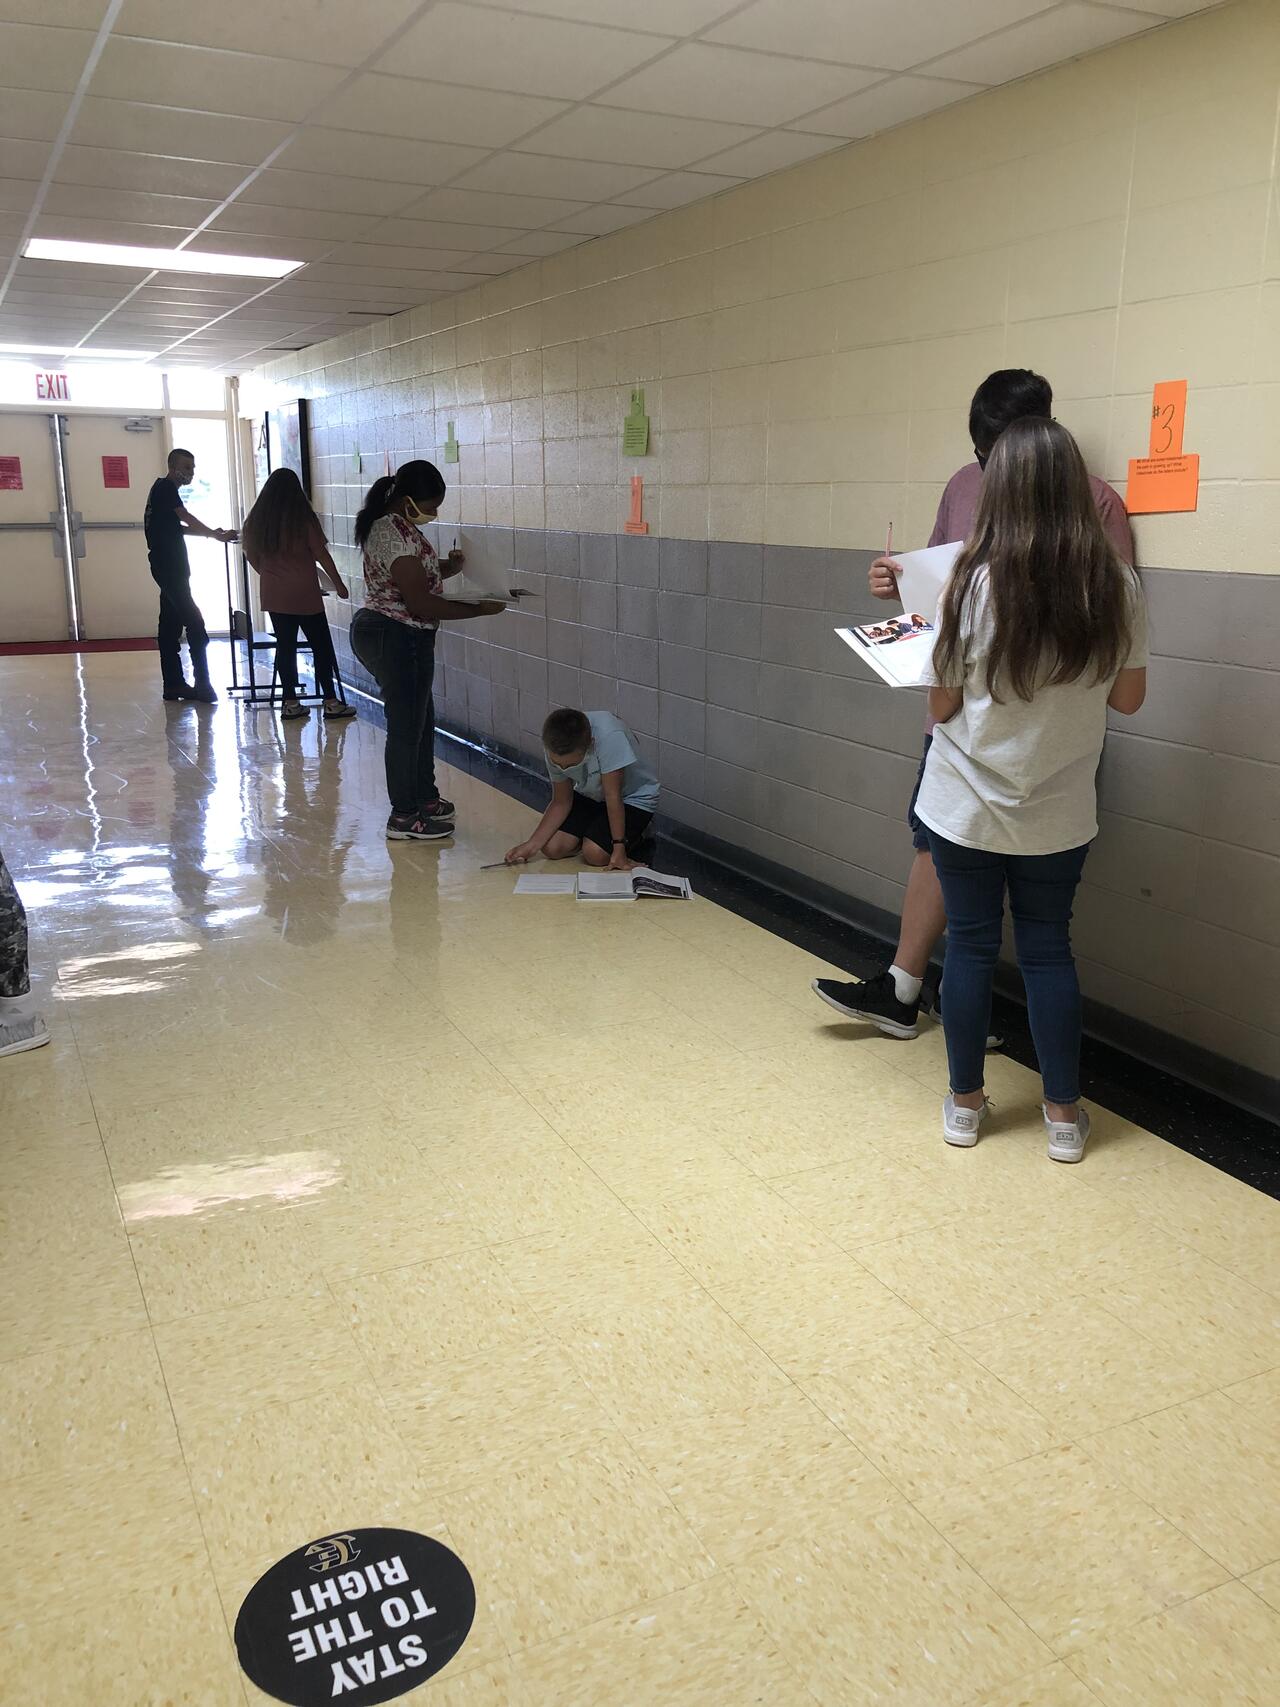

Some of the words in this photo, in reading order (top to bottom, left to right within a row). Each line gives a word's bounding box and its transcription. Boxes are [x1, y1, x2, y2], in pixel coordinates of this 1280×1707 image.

[36, 374, 69, 399] EXIT
[289, 1555, 410, 1621] RIGHT
[380, 1589, 437, 1628] TO
[287, 1611, 373, 1663] THE
[331, 1634, 428, 1697] STAY
